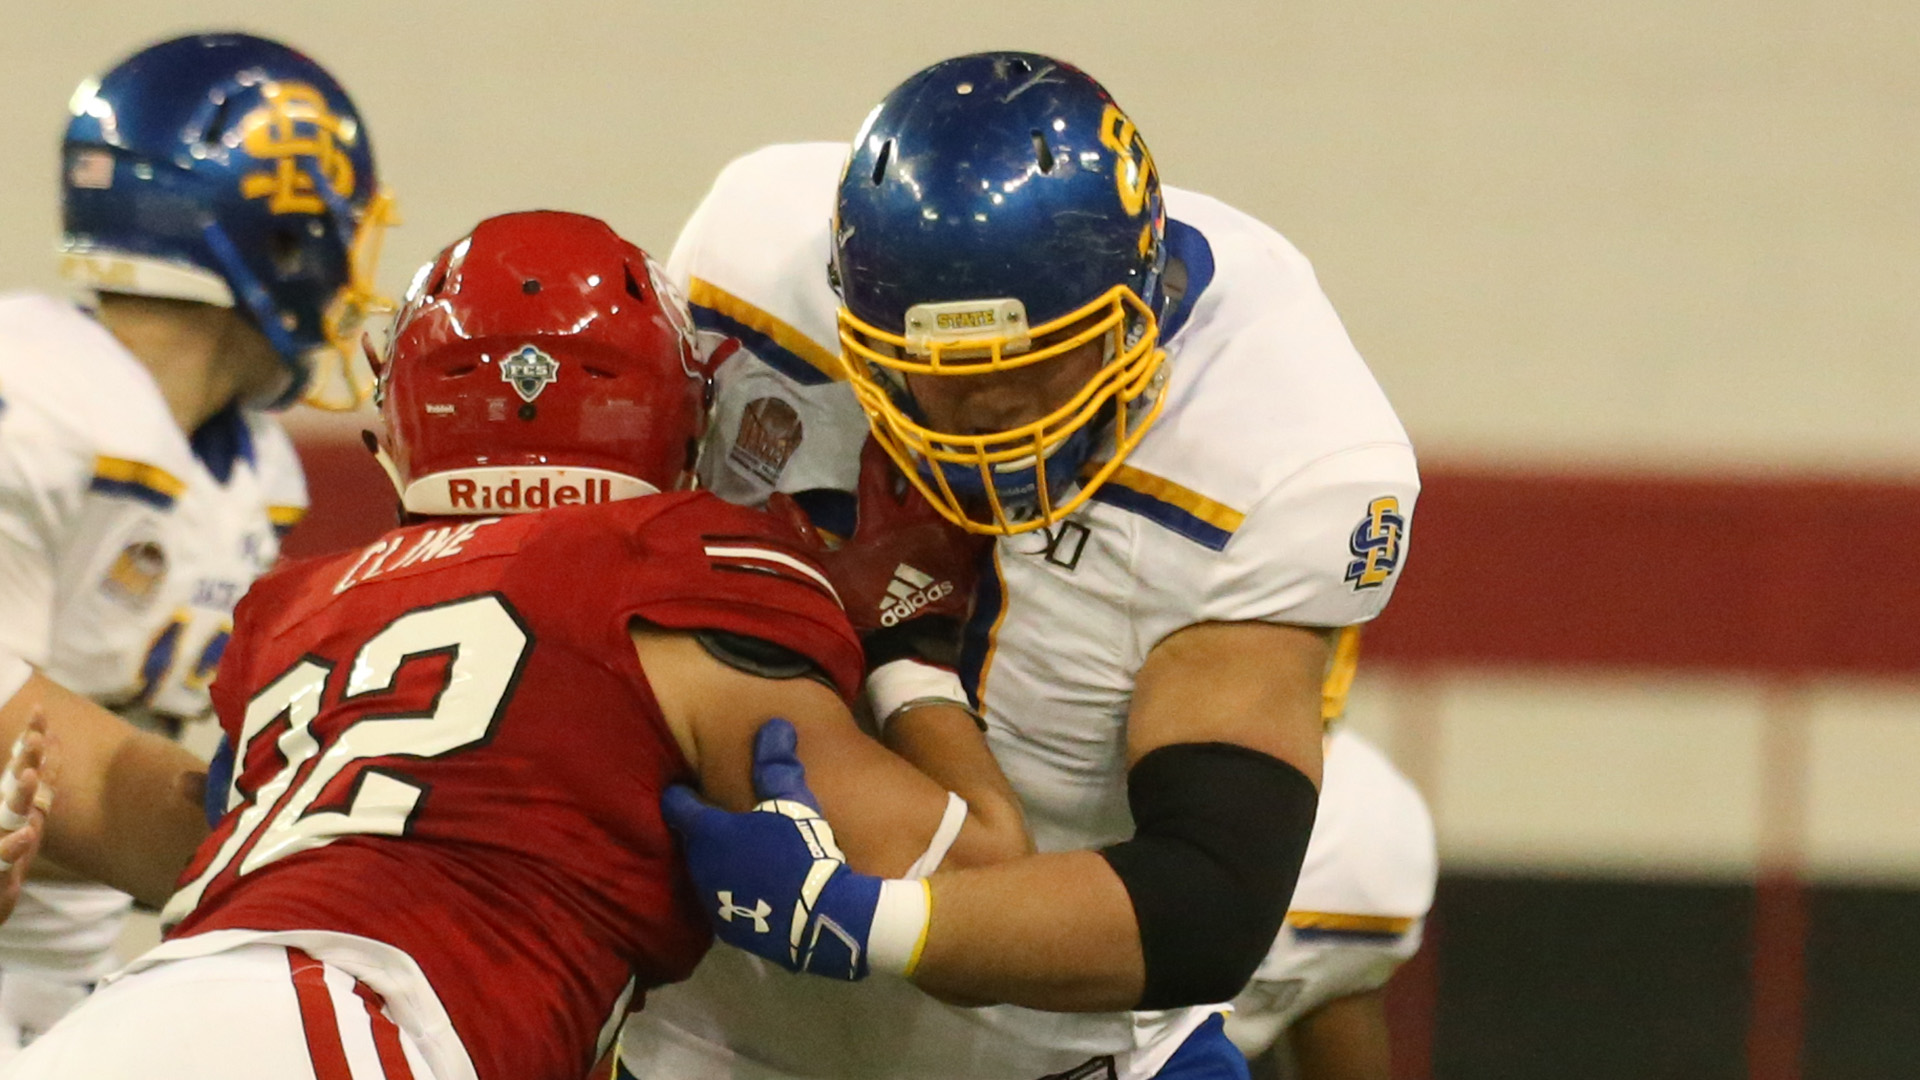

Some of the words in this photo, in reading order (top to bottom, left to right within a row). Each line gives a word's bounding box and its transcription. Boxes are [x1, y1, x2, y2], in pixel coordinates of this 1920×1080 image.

[937, 310, 995, 329] STATE
[510, 364, 549, 376] FCS
[448, 478, 612, 509] Riddell
[332, 517, 502, 595] CLINE
[880, 581, 954, 628] adidas
[160, 594, 531, 938] 92
